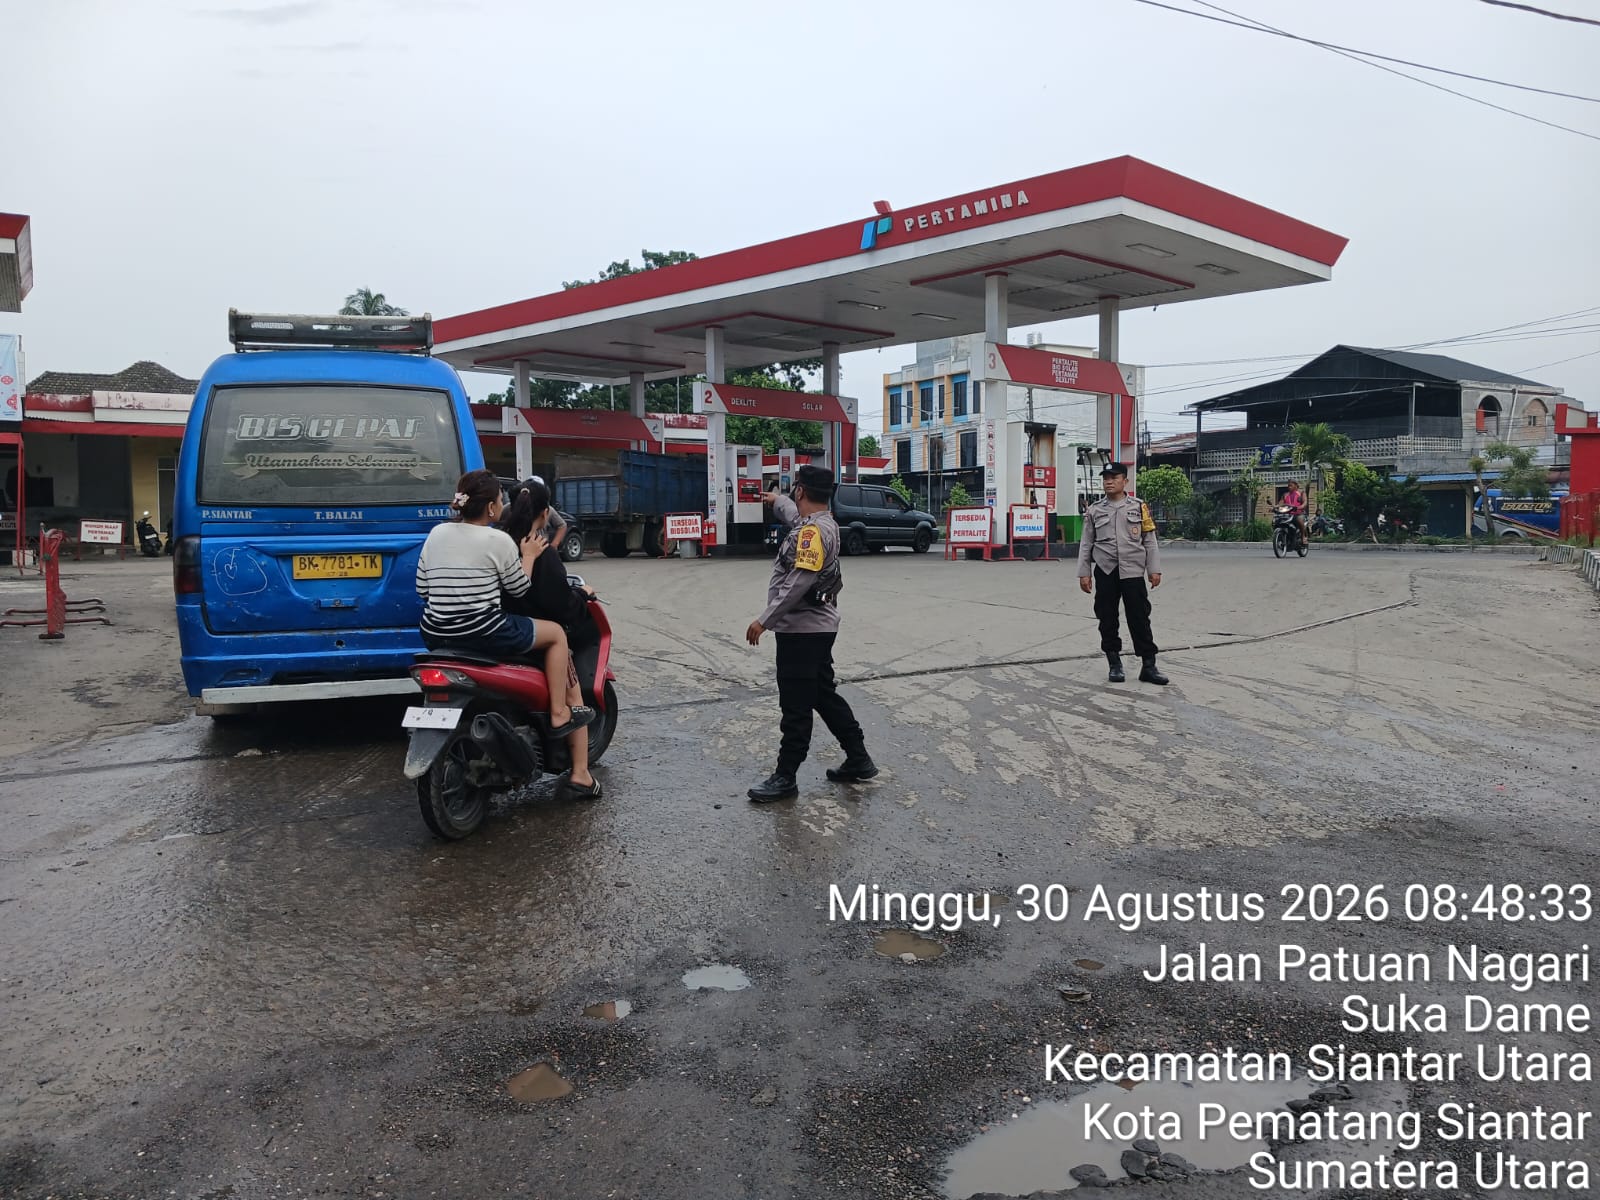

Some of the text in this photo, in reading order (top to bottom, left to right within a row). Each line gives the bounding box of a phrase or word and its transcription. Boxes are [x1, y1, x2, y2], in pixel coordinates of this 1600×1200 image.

[904, 190, 1029, 232] PERTAMINA
[988, 352, 997, 370] 3
[704, 390, 713, 404] 2
[731, 397, 757, 408] DEXLITE
[802, 402, 823, 412] SOLAR
[513, 414, 519, 426] 1
[246, 454, 418, 468] Utamakan Selamat
[202, 509, 253, 520] P.SIANTAR
[314, 511, 363, 520] T.BALAI
[955, 514, 986, 522] TERSEDIA
[953, 529, 987, 537] PERTALITE
[299, 555, 378, 570] BK 7781 TK
